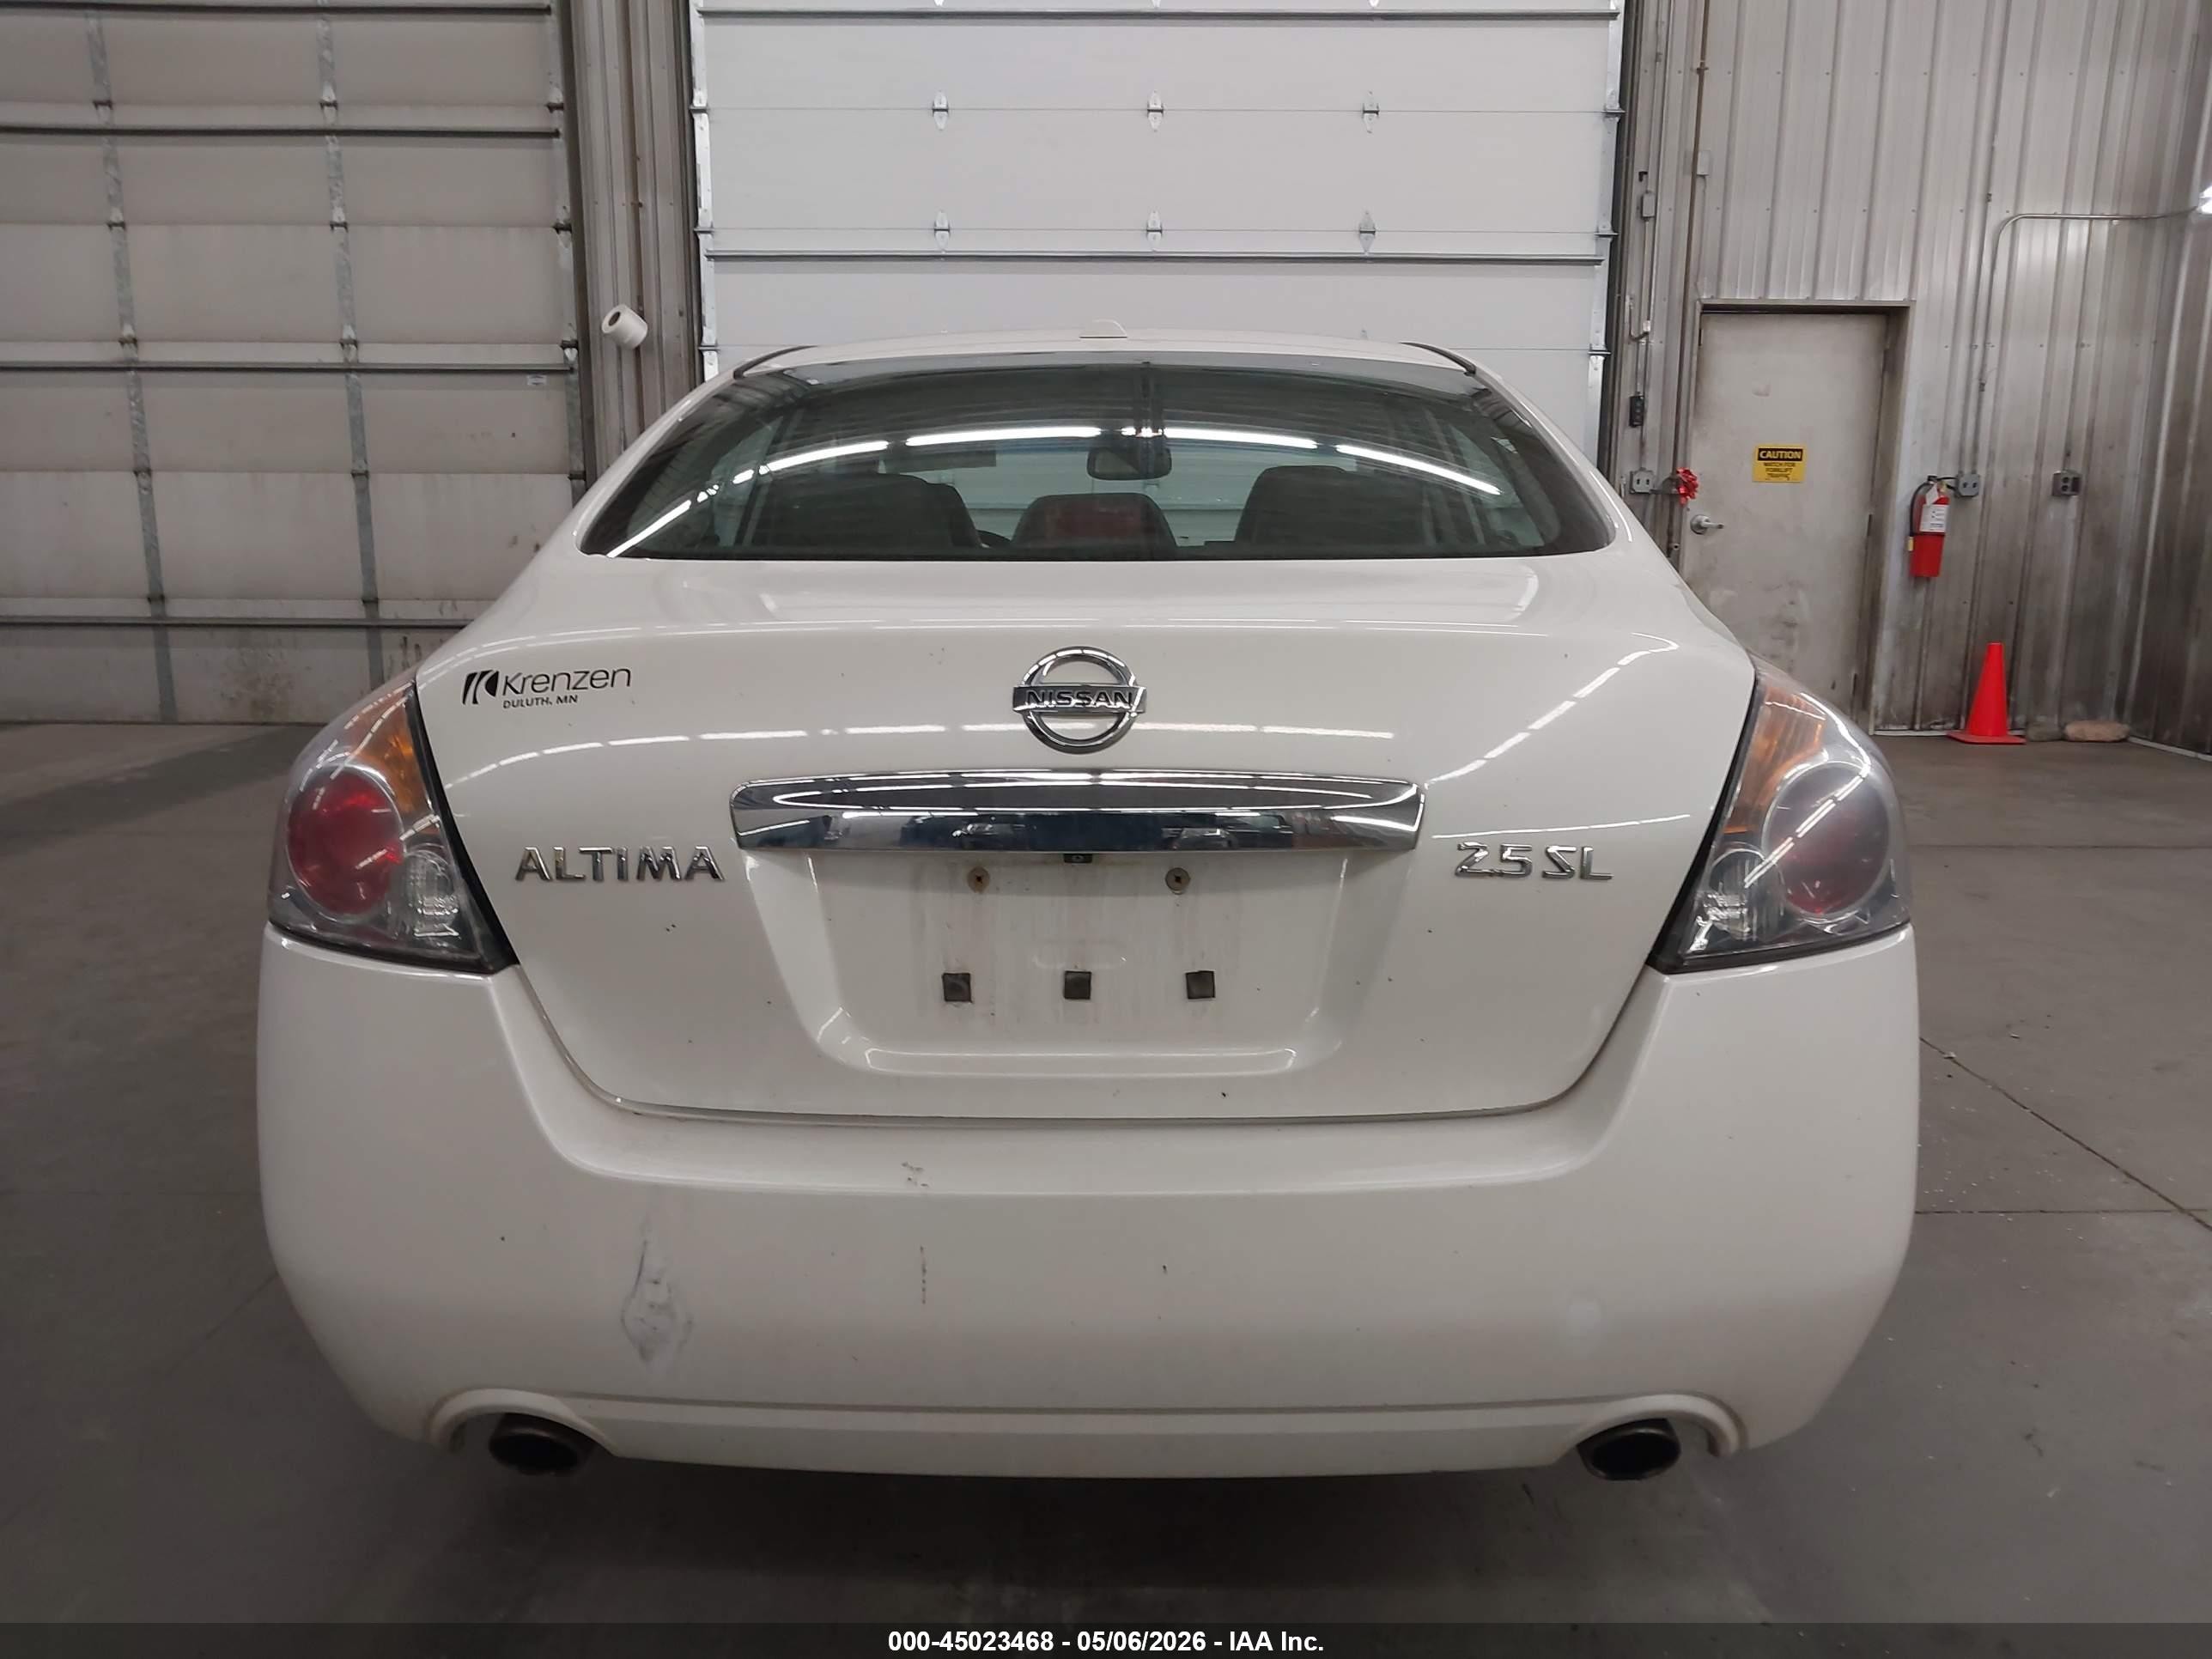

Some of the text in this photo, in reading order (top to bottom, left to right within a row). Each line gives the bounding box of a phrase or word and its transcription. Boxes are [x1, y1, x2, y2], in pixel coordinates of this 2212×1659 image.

[1759, 450, 1802, 459] CAUTION
[502, 668, 631, 696] Krenzen
[556, 695, 578, 704] MN
[1026, 690, 1133, 708] NISSAN
[515, 846, 725, 881] ALTIMA
[1542, 846, 1614, 879] SL
